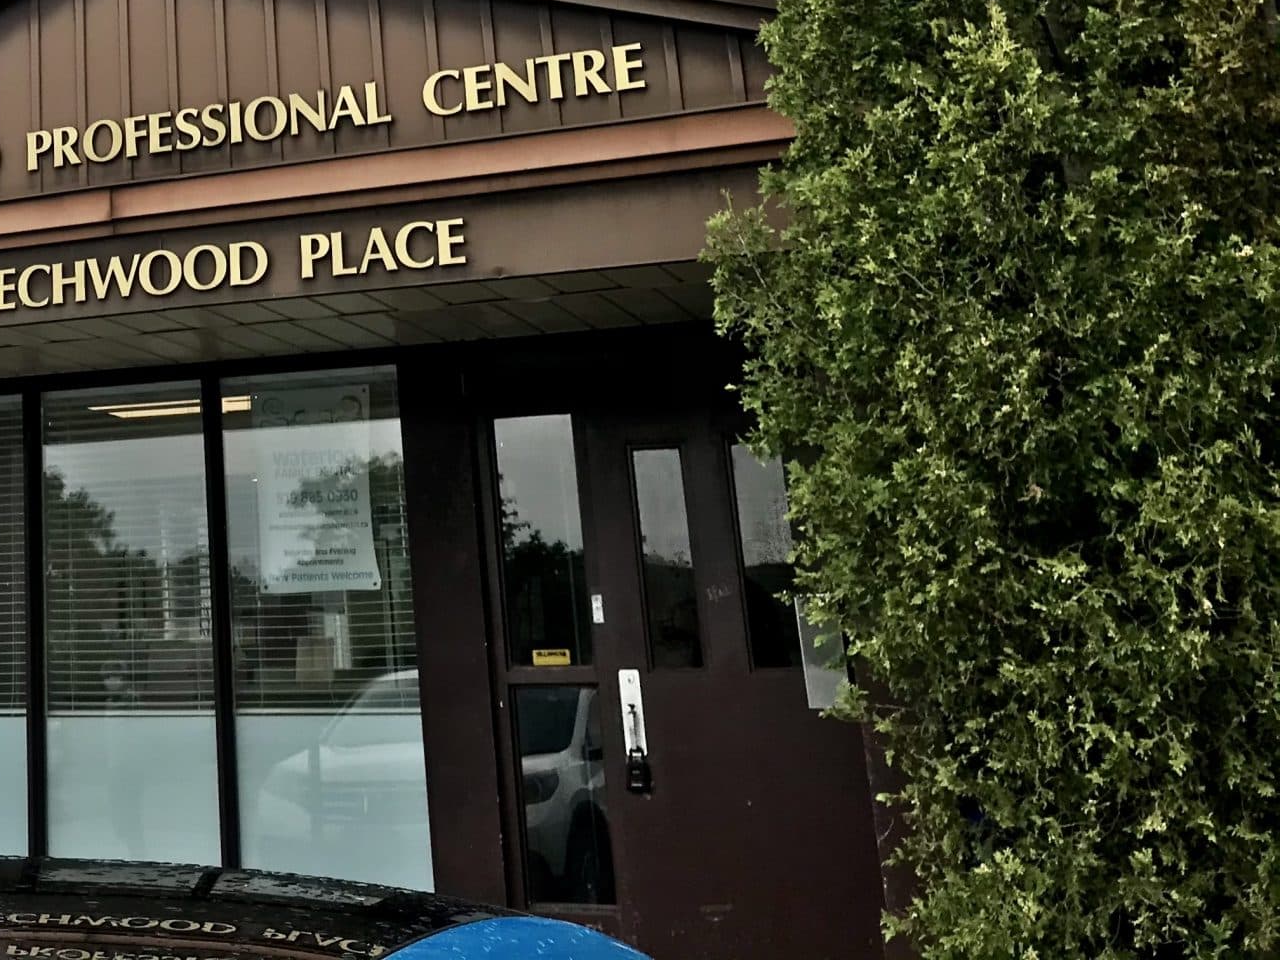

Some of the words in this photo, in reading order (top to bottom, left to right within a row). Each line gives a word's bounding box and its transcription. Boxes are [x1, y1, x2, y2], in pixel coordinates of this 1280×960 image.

[25, 81, 392, 172] PROFESSIONAL
[422, 42, 647, 117] CENTRE
[300, 217, 468, 279] PLACE
